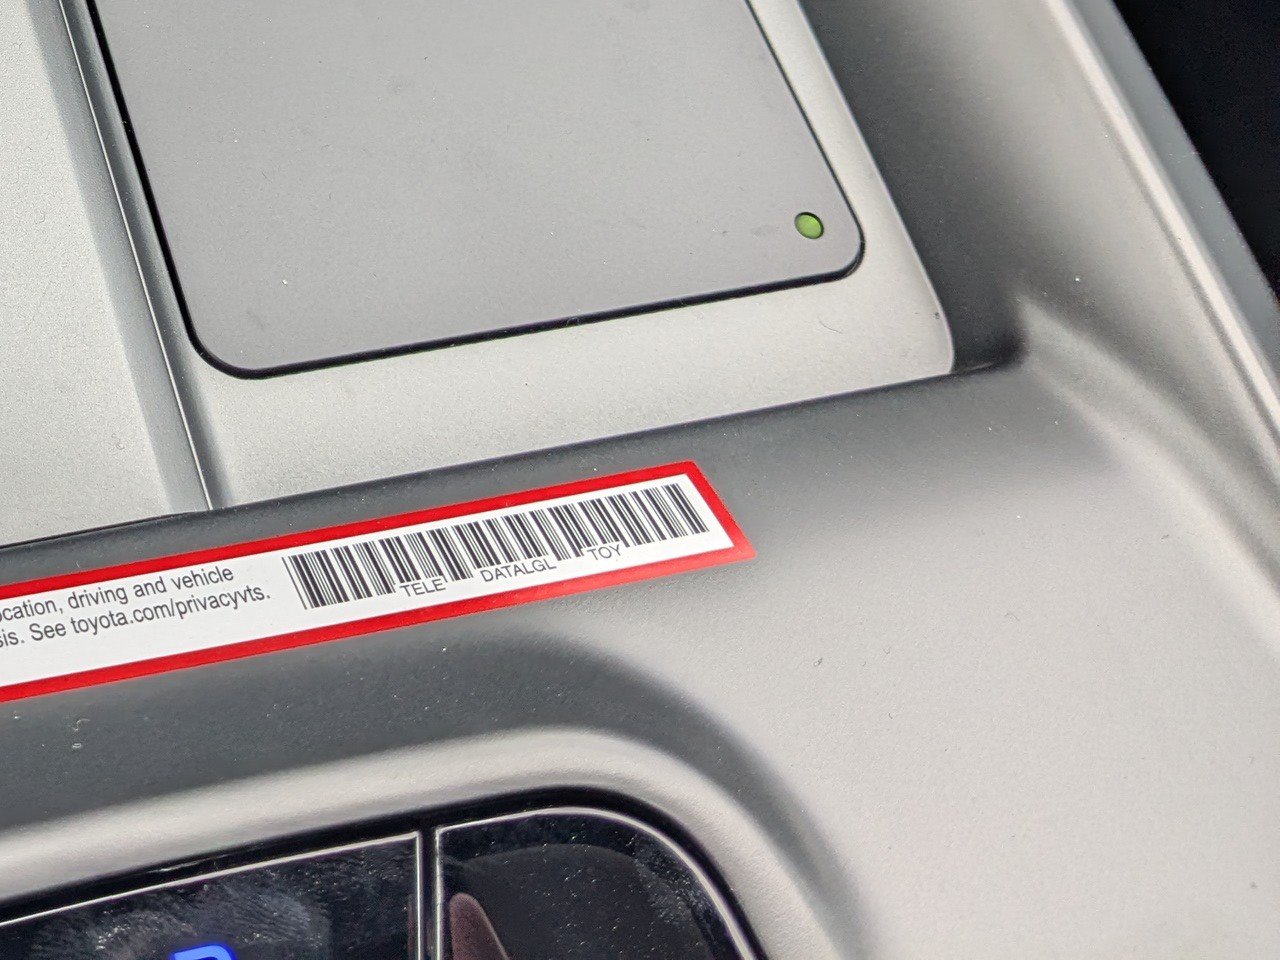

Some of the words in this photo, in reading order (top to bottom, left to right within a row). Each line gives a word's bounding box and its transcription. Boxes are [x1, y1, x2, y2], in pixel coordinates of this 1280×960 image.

[67, 586, 129, 610] driving
[132, 575, 168, 598] and
[170, 565, 234, 590] vehicle
[399, 578, 446, 597] TELE
[479, 558, 557, 583] DATALGL
[586, 544, 621, 561] TOY
[28, 622, 67, 642] See
[70, 585, 271, 636] toyota.com/privacyvts.
